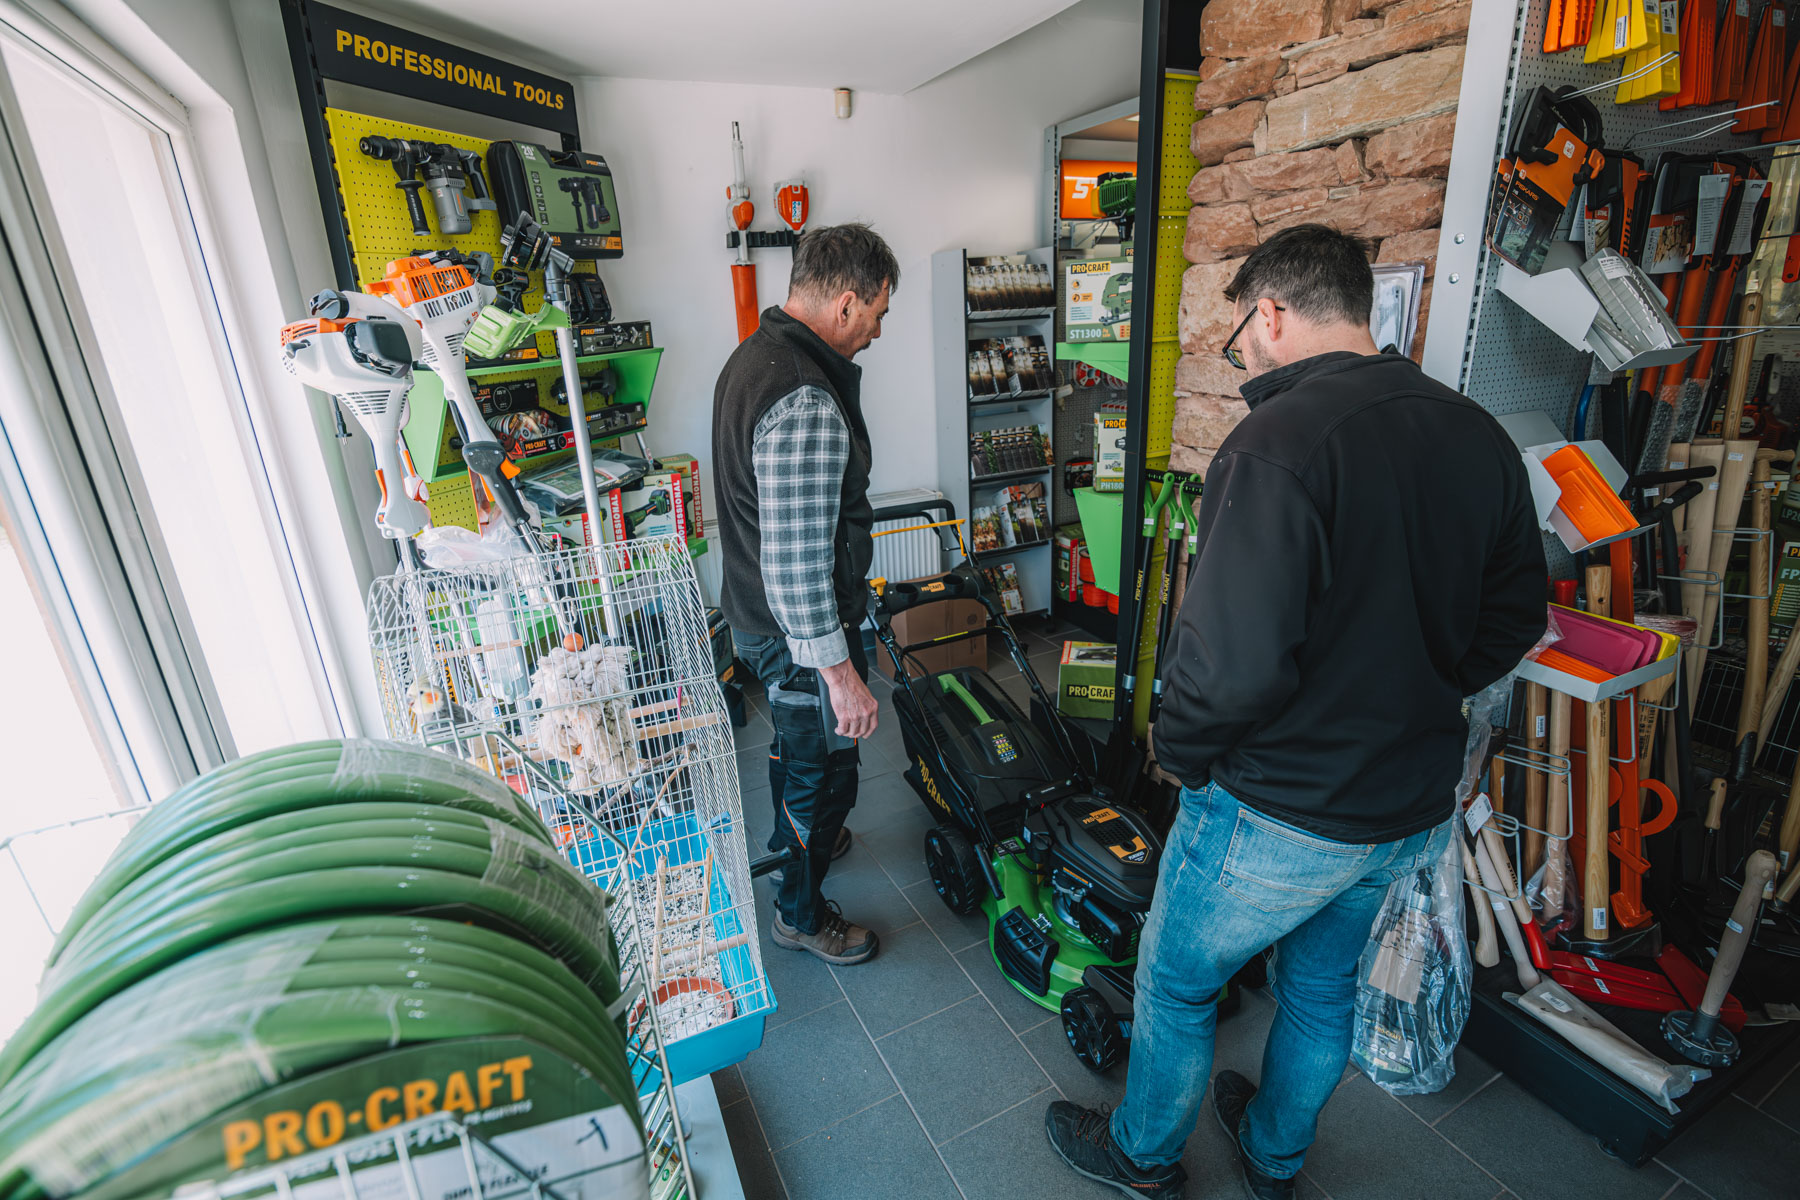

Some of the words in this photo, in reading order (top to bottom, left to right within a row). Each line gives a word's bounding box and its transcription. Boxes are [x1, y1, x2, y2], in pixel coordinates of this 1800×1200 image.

[336, 29, 507, 97] PROFESSIONAL
[513, 80, 564, 111] TOOLS
[1069, 328, 1102, 339] ST1300
[692, 469, 703, 533] PROFESSIONAL
[1068, 686, 1115, 698] PRO-CRAF
[222, 1055, 533, 1171] PRO-CRAFT
